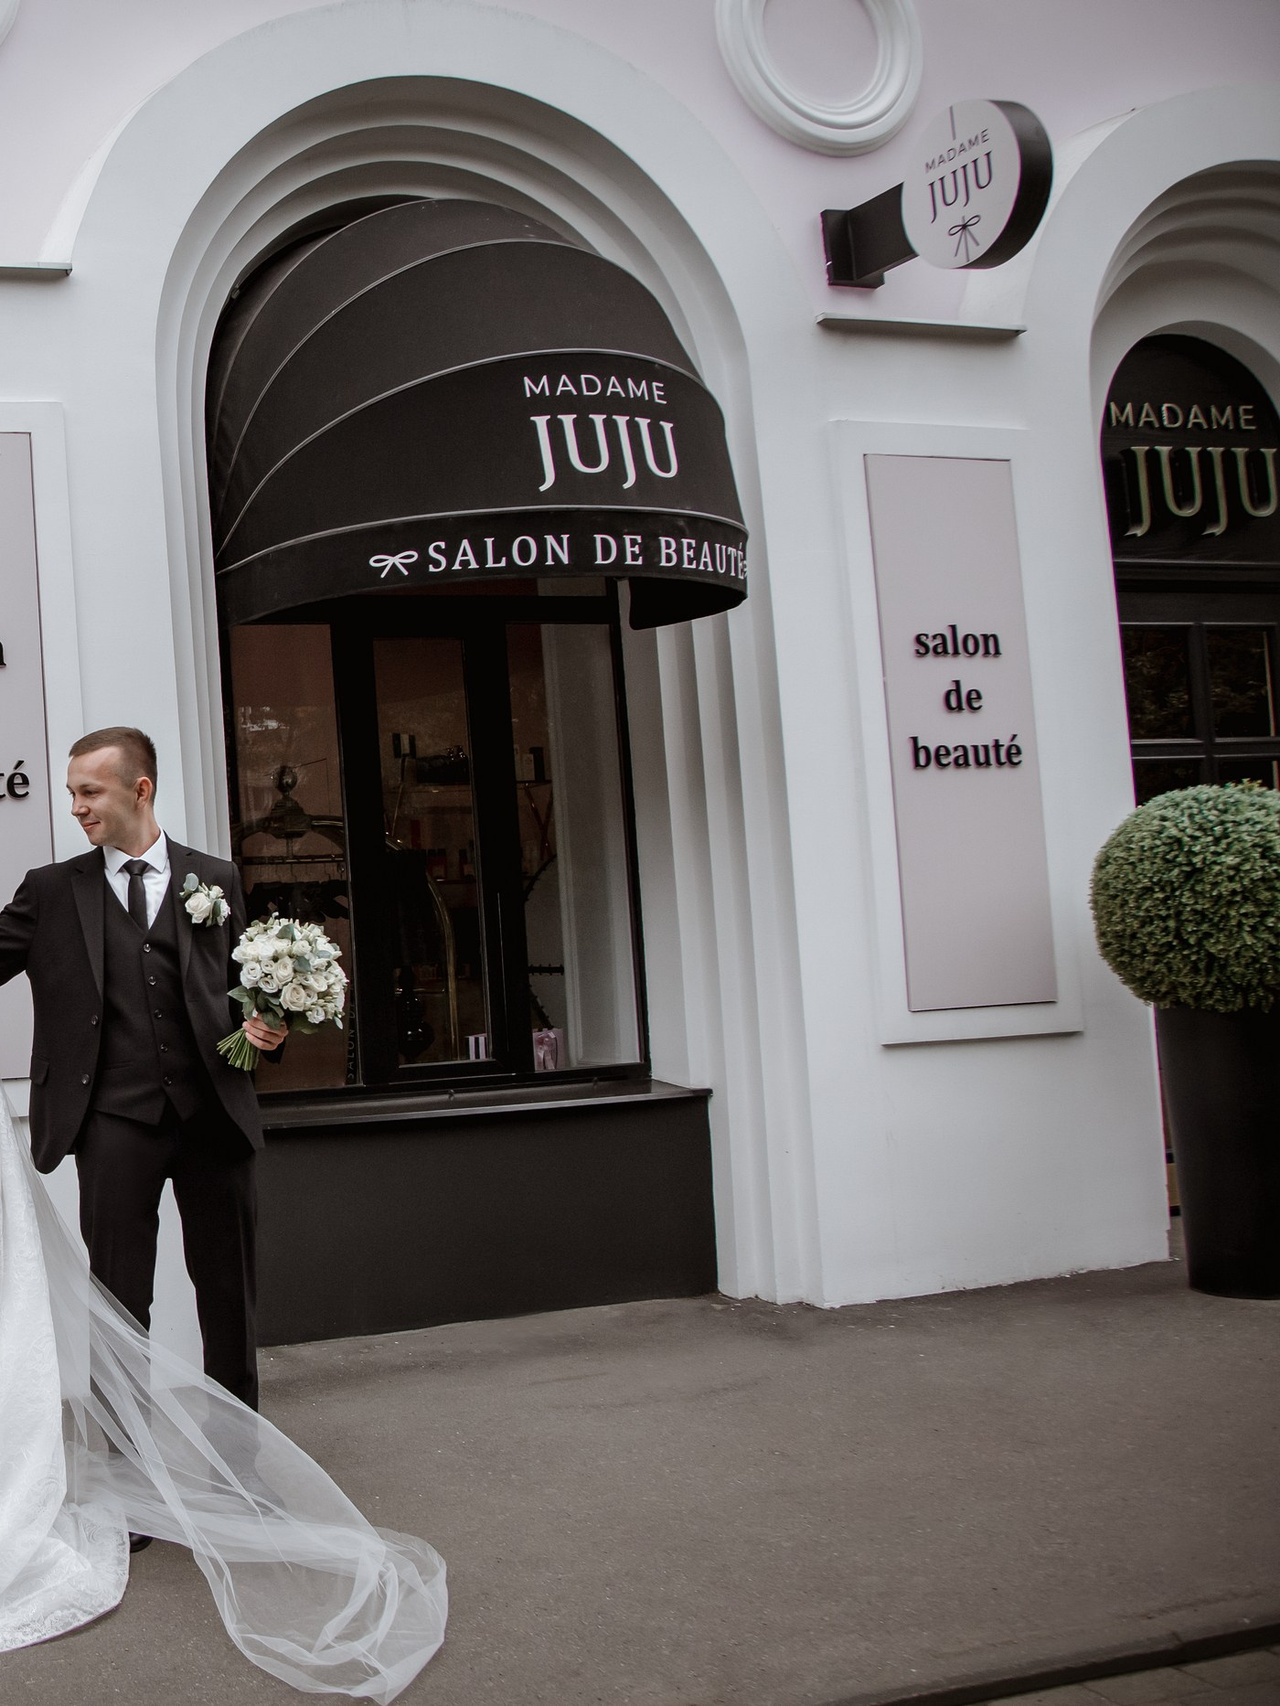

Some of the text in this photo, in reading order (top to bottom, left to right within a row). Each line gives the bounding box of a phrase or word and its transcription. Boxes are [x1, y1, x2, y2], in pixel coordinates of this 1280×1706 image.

[924, 128, 991, 174] MADAME
[927, 150, 993, 224] JUJU
[523, 374, 668, 405] MADAME
[1109, 402, 1257, 430] MADAME
[529, 413, 679, 492] JUJU
[1124, 445, 1278, 537] JUJU
[428, 534, 745, 580] SALON DE BEAUTÉ
[914, 624, 1002, 658] salon
[944, 679, 983, 713] de
[909, 733, 1022, 769] beauté
